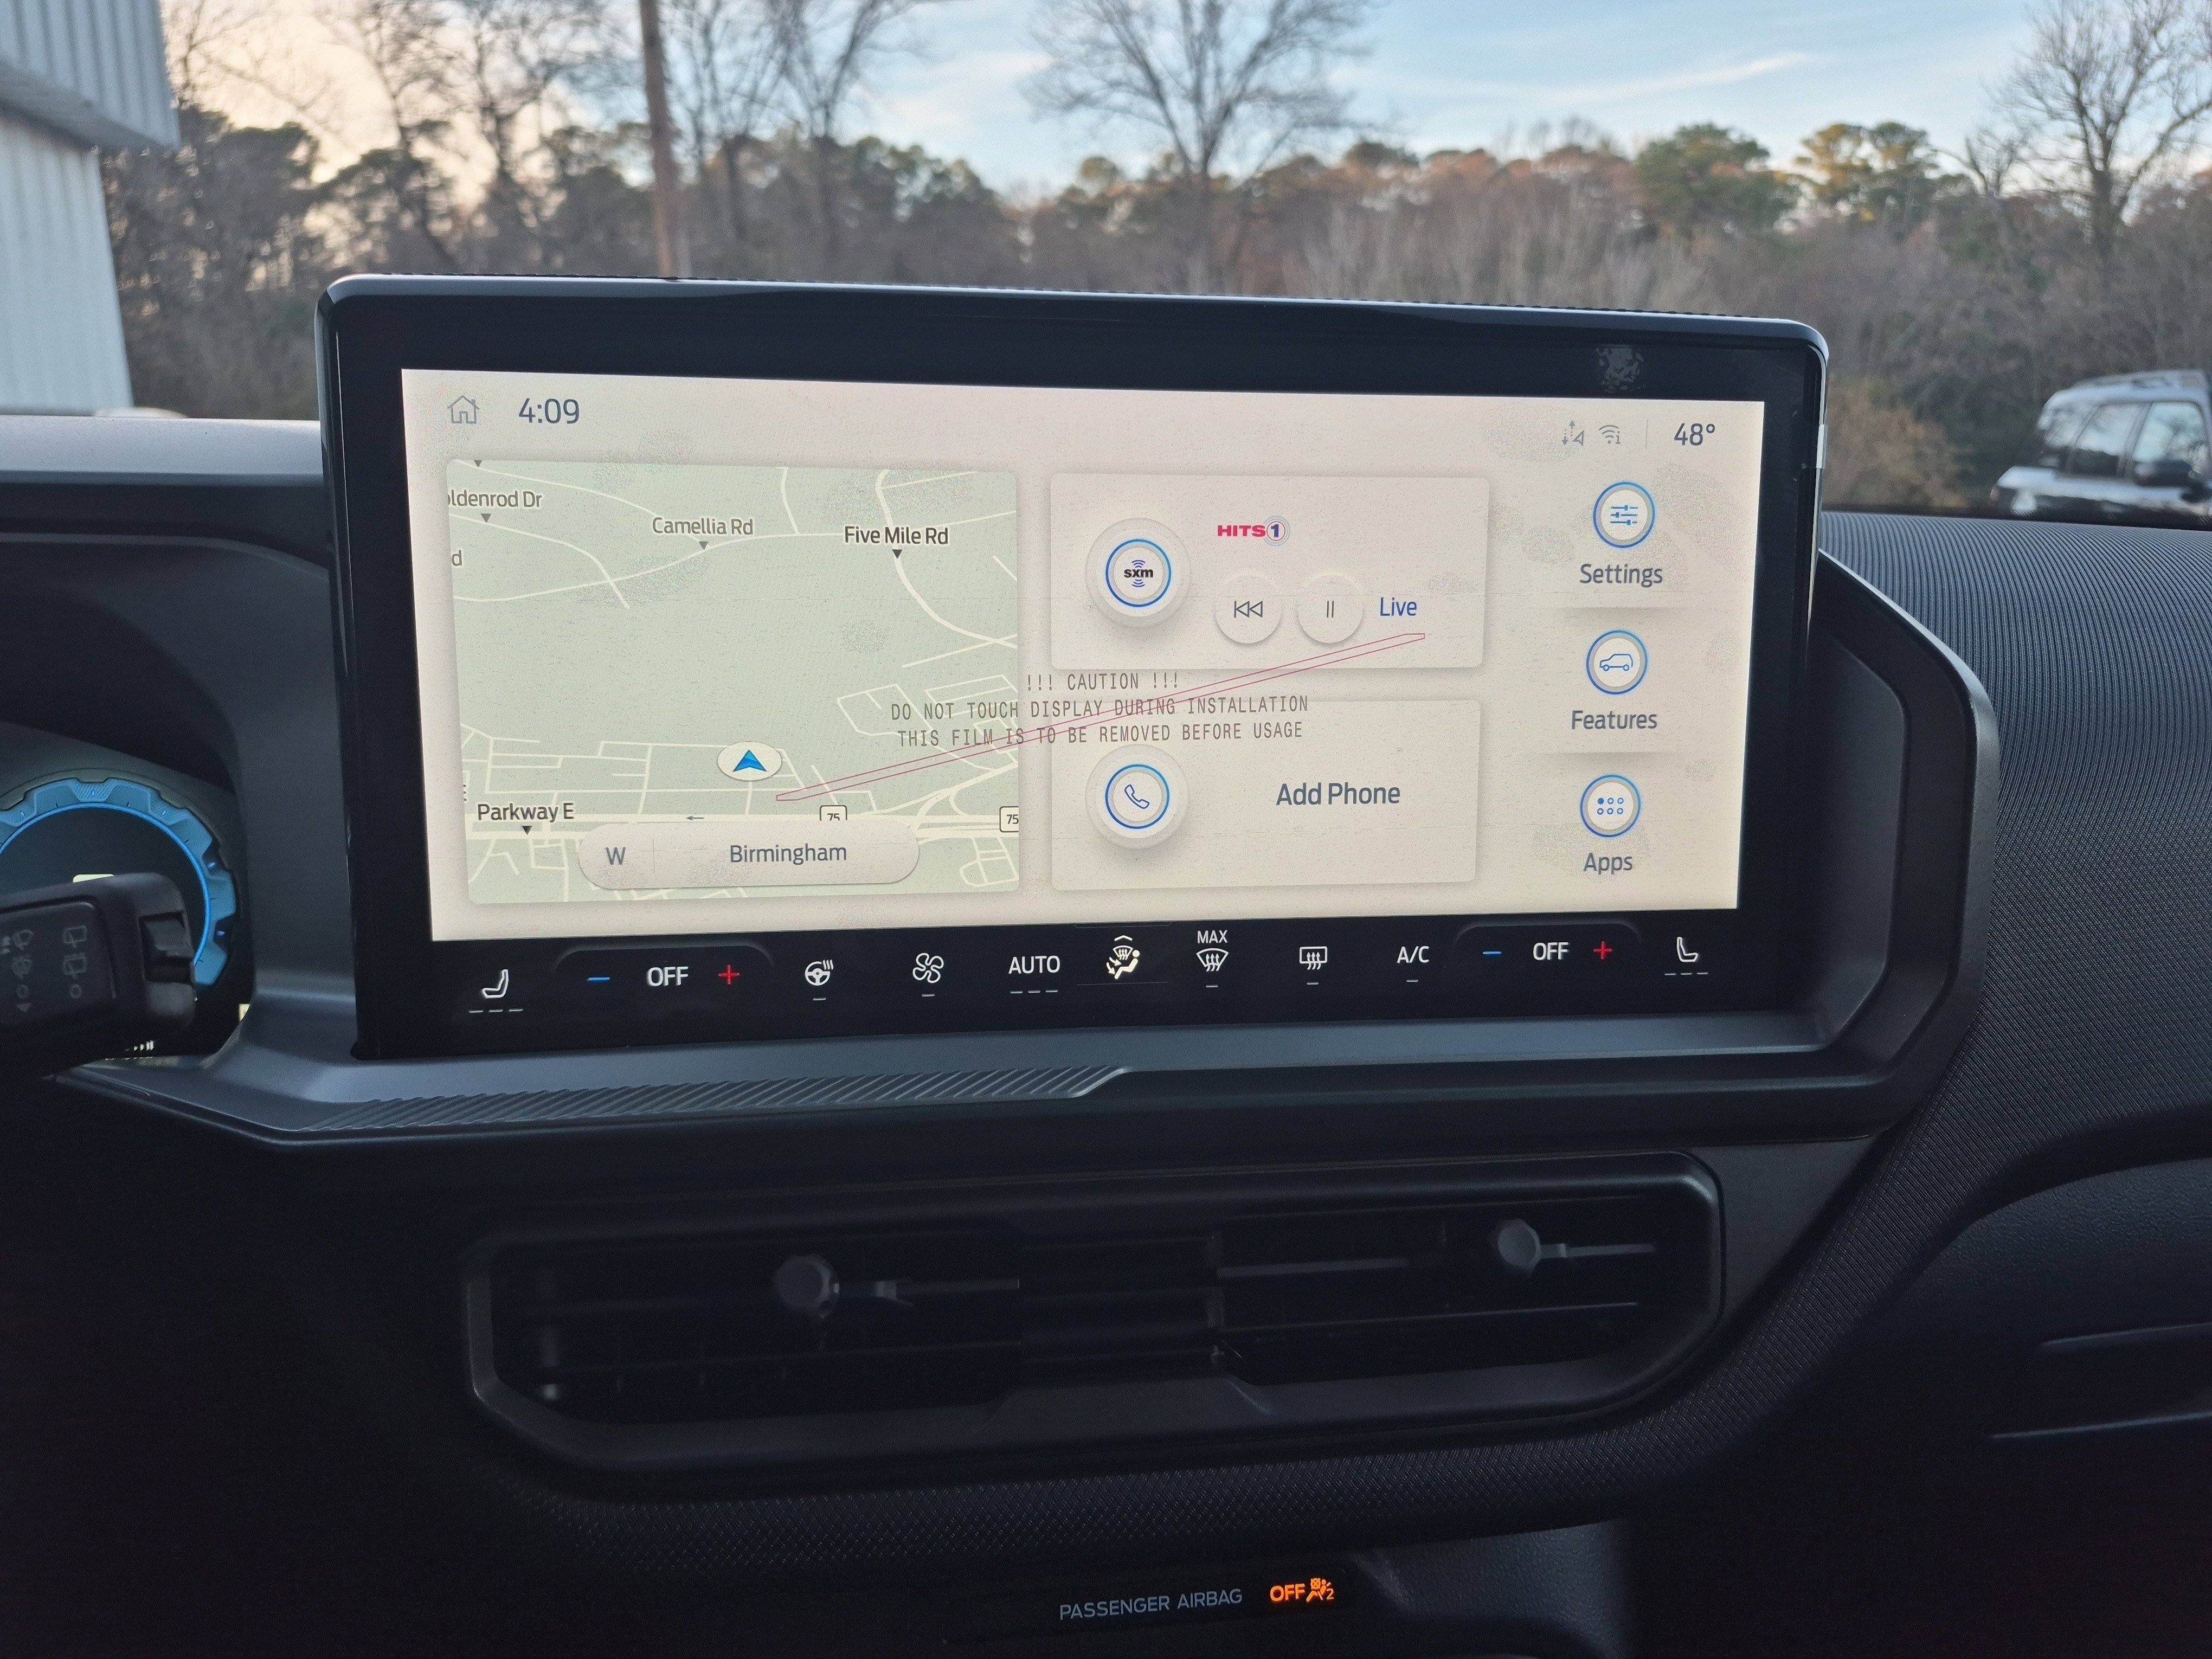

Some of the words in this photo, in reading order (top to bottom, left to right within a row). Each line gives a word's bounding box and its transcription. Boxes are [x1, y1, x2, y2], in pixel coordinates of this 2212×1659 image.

[518, 398, 580, 425] 4:09
[1674, 423, 1716, 446] 48°
[523, 491, 542, 507] Dr
[652, 517, 726, 535] Camellia
[731, 518, 754, 535] Rd
[845, 526, 880, 544] Five
[885, 526, 921, 544] Mile
[925, 528, 949, 545] Rd
[1123, 567, 1154, 578] sxm
[1579, 563, 1663, 588] Settings
[1380, 597, 1417, 617] Live
[1067, 673, 1139, 690] CAUTION
[891, 703, 912, 720] DO
[924, 703, 955, 719] NOT
[968, 702, 1018, 718] TOUCH
[1031, 699, 1103, 718] DISPLAY
[1114, 698, 1176, 716] DURING
[1187, 696, 1309, 715] INSTALLATION
[1571, 710, 1658, 730] Features
[897, 730, 939, 747] THIS
[952, 729, 993, 745] FILM
[1006, 728, 1024, 744] IS
[1038, 726, 1057, 744] TO
[1068, 726, 1087, 743] BE
[1099, 724, 1171, 743] REMOVED
[1182, 723, 1242, 741] BEFORE
[1253, 721, 1302, 738] USAGE
[1276, 783, 1322, 806] Add
[1328, 782, 1400, 805] Phone
[478, 803, 559, 822] Parkway
[563, 803, 575, 820] E
[1006, 814, 1019, 825] 75
[606, 846, 626, 865] W
[730, 843, 847, 865] Birmingham
[1583, 852, 1634, 874] Apps
[1197, 930, 1229, 944] MAX
[1397, 946, 1430, 963] A/C
[1533, 942, 1569, 960] OFF
[1008, 955, 1061, 974] AUTO
[647, 967, 689, 986] OFF
[1270, 1583, 1306, 1603] OFF
[1059, 1595, 1171, 1621] PASSENGER
[1177, 1589, 1243, 1610] AIRBAG
